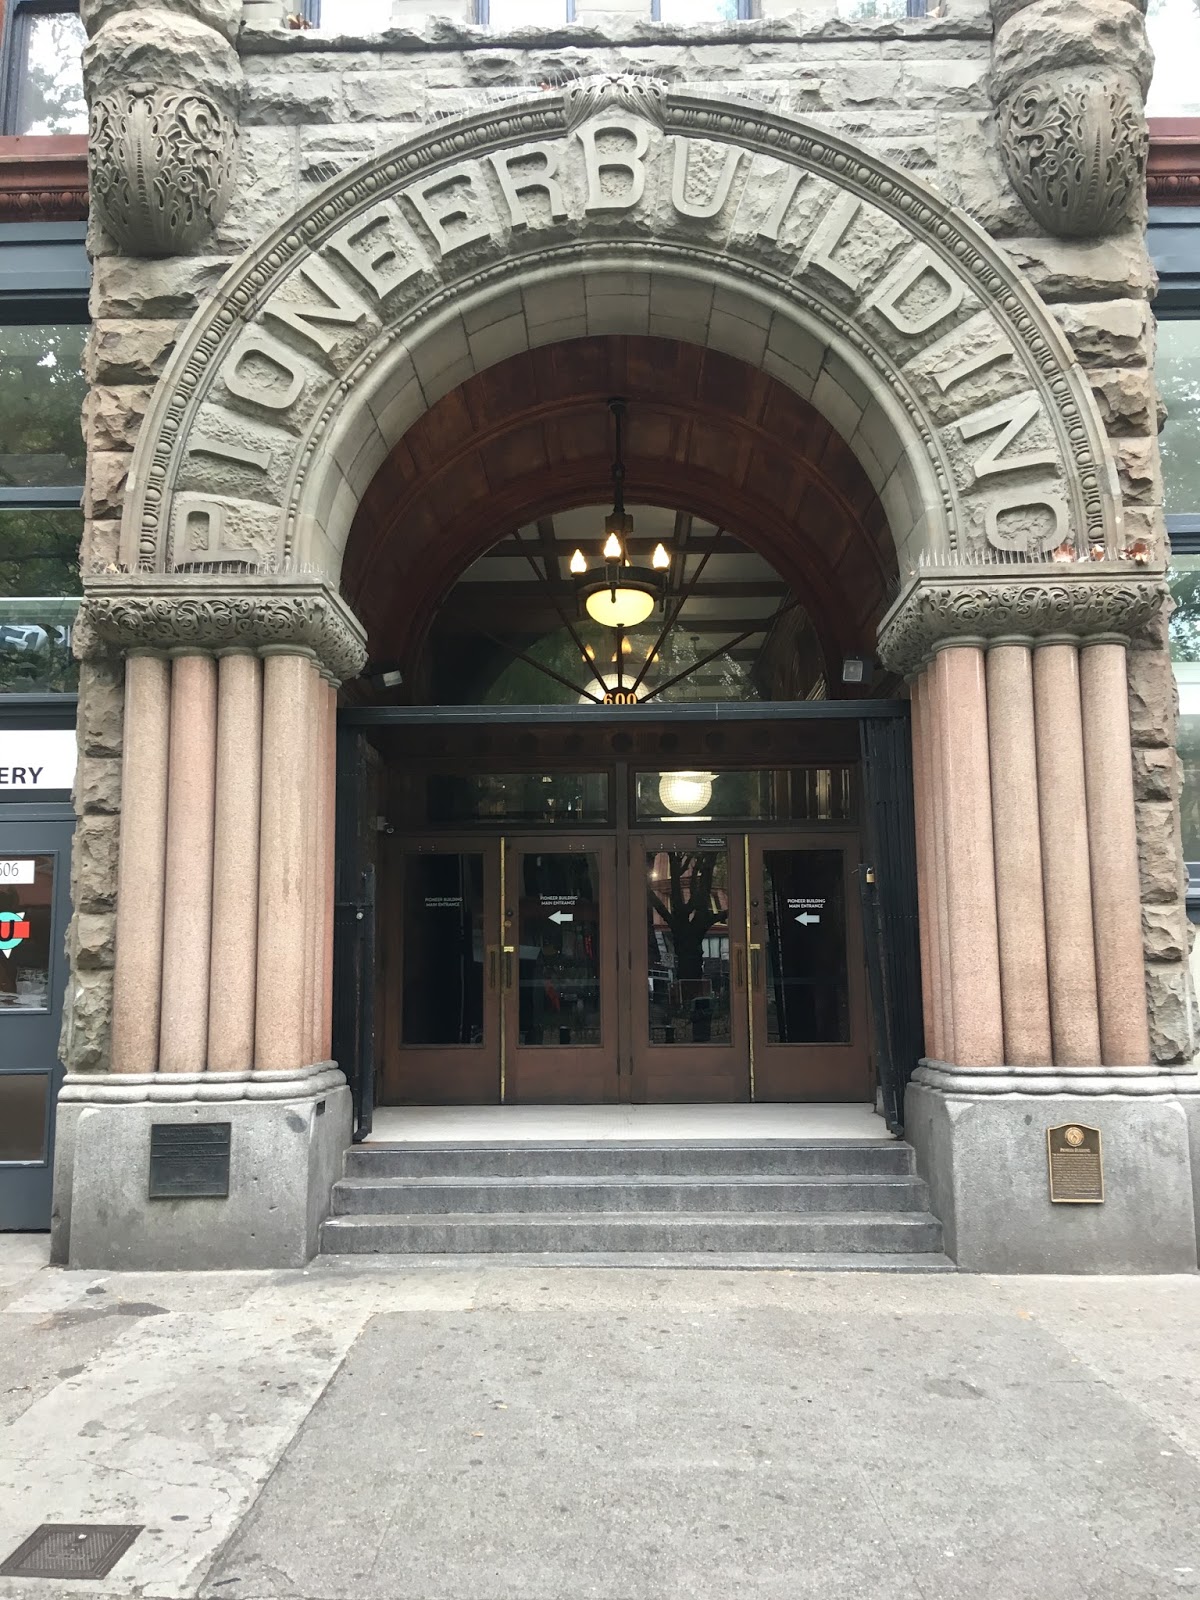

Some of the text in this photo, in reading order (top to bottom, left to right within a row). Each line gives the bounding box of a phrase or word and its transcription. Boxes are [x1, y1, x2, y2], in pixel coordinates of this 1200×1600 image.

[173, 117, 1069, 566] PIONEER BUILDING
[603, 692, 637, 704] 600
